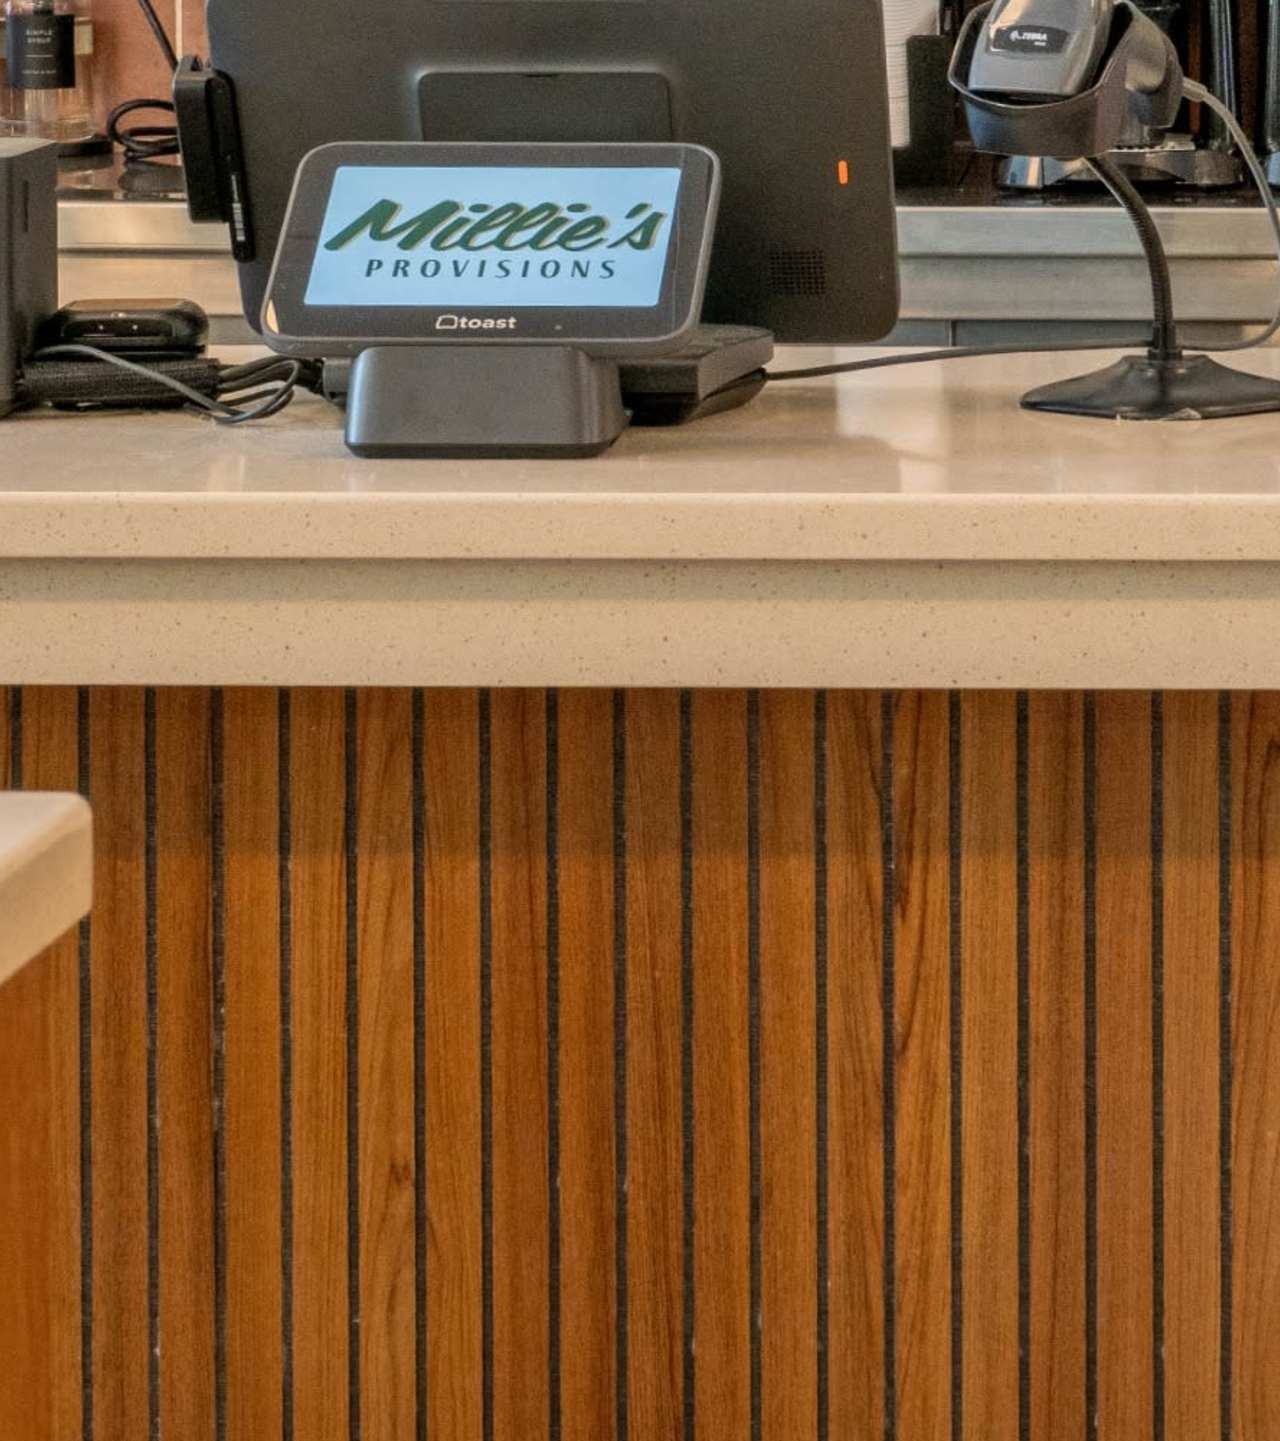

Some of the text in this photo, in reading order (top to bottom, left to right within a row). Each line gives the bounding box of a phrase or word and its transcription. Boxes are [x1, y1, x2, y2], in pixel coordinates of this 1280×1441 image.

[324, 199, 666, 252] Millie's
[365, 260, 617, 279] PROVISIONS
[456, 316, 517, 330] toast
